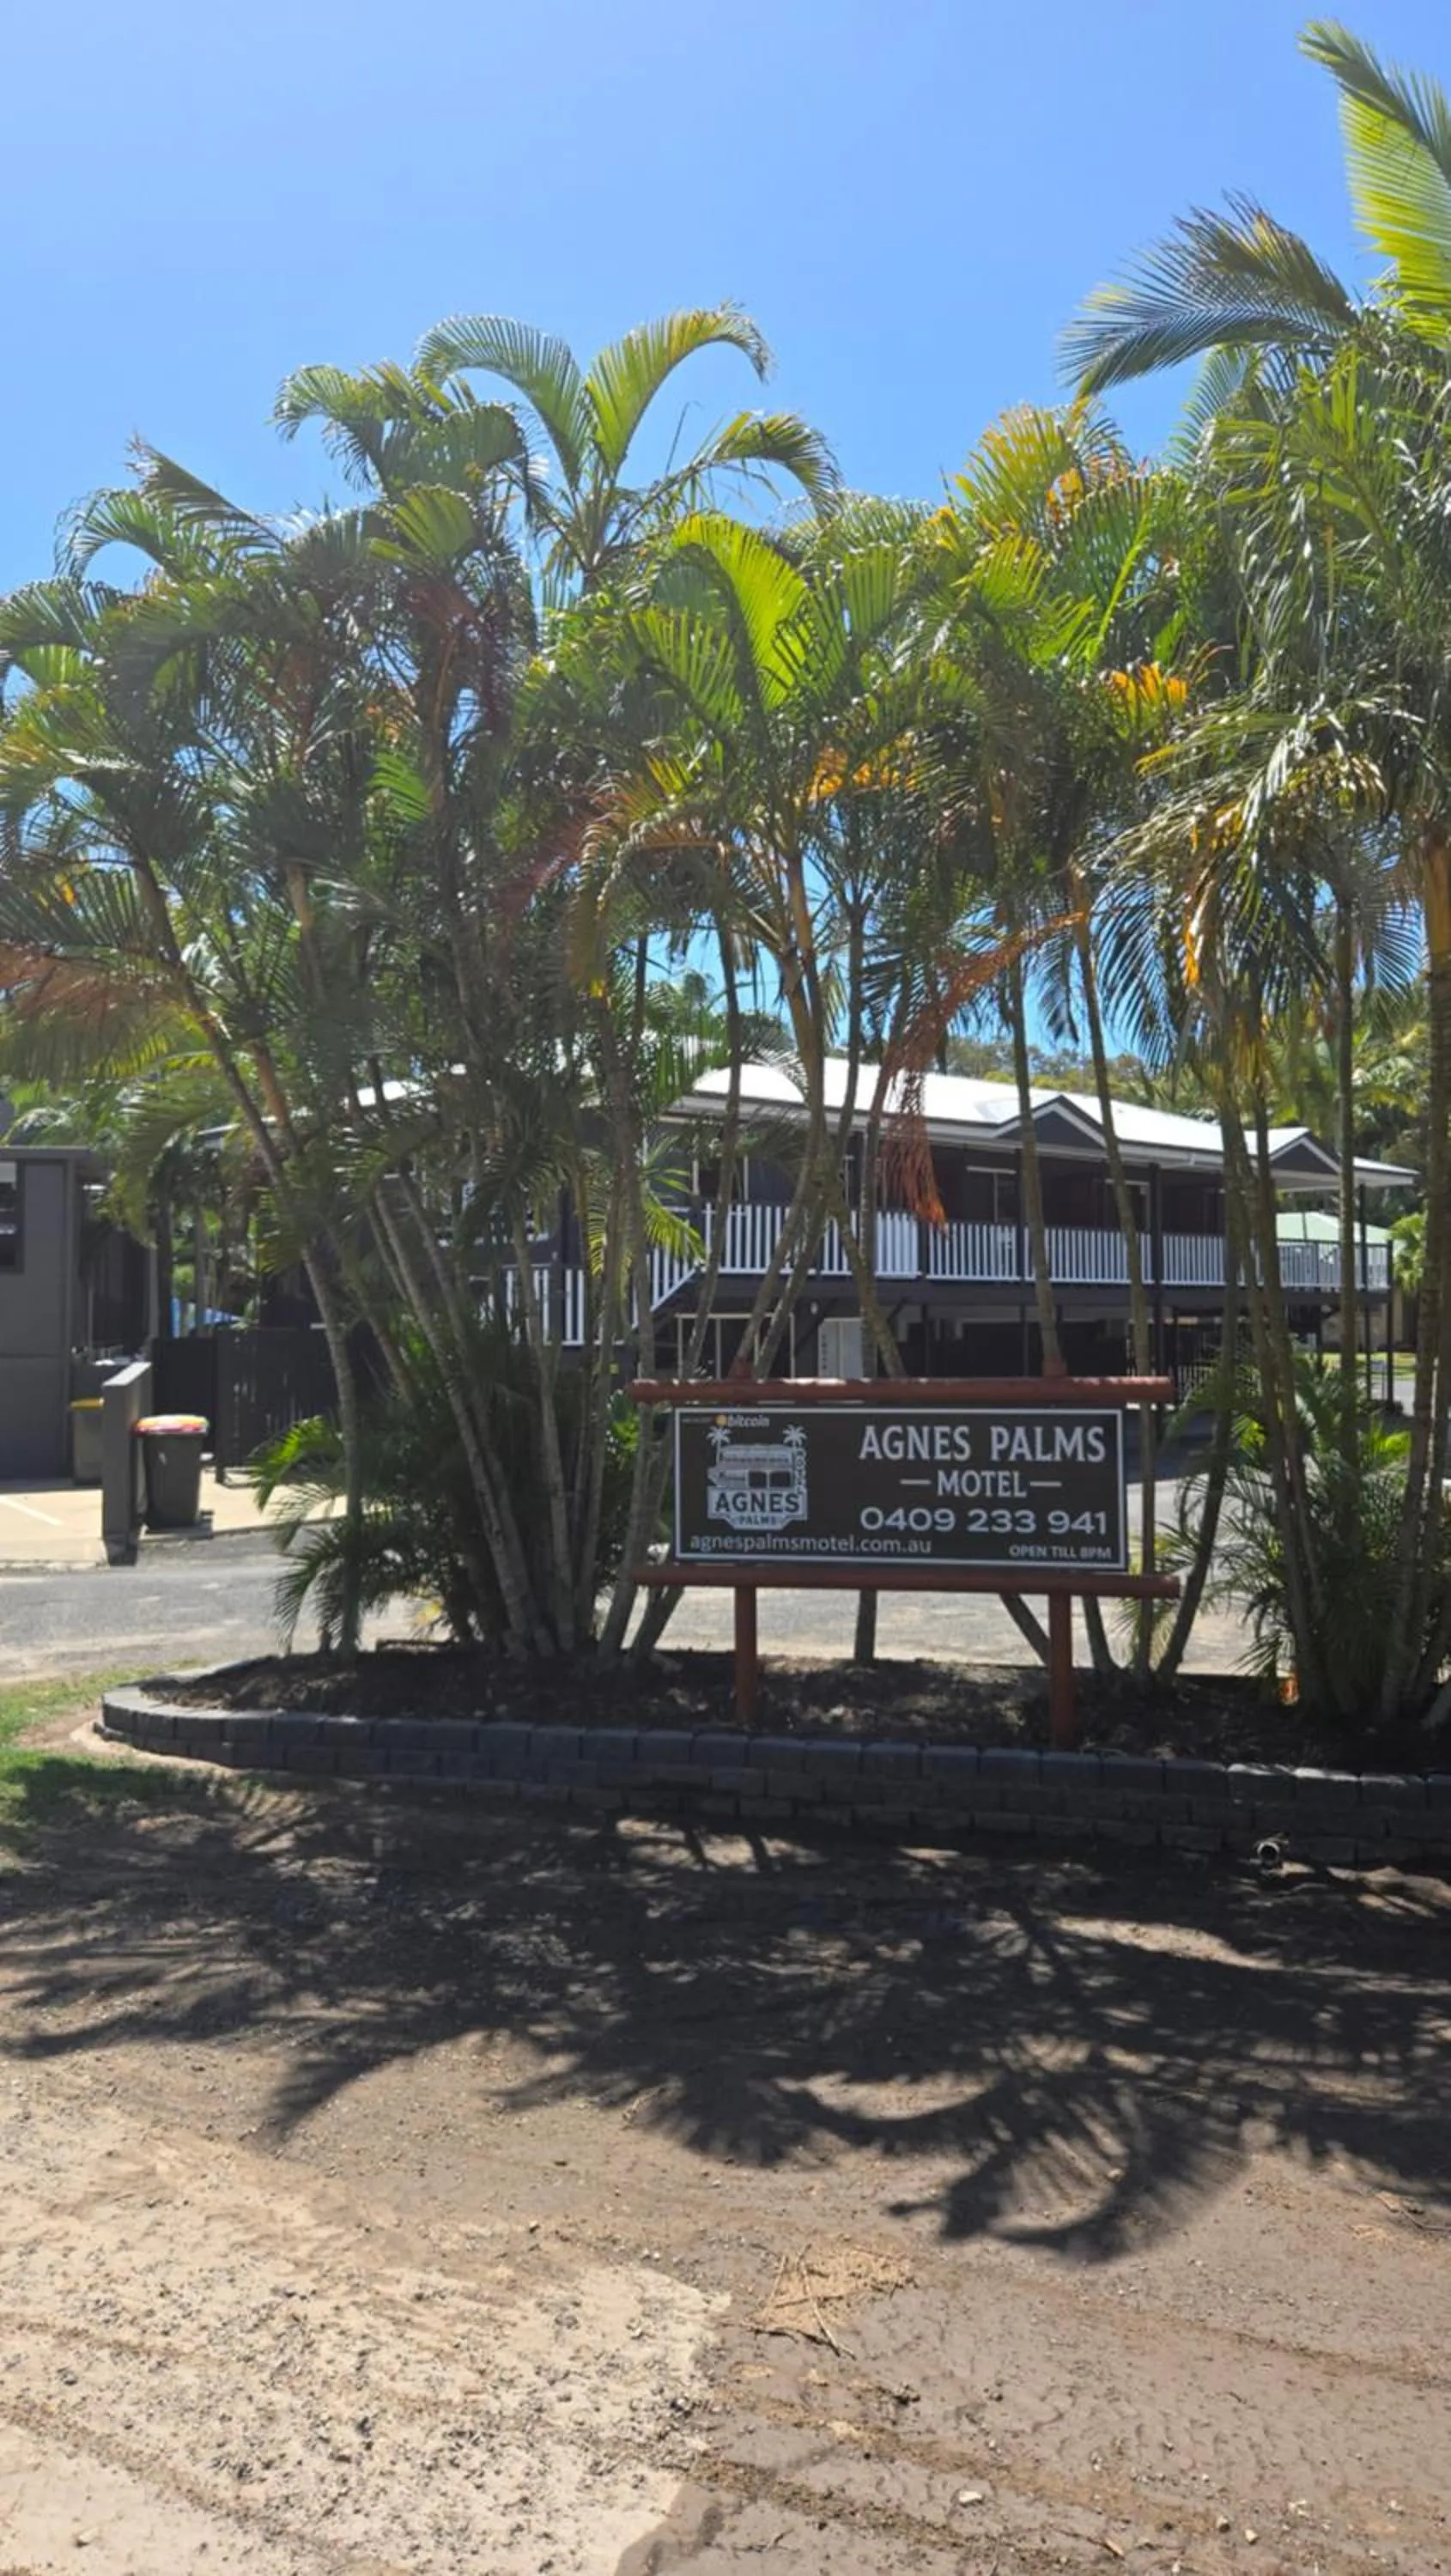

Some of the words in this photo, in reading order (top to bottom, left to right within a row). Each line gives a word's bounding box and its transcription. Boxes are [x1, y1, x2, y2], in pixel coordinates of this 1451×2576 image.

[859, 1425, 971, 1461] AGNES
[990, 1426, 1107, 1462] PALMS
[937, 1469, 1027, 1498] MOTEL
[714, 1492, 800, 1512] AGNES
[860, 1507, 956, 1532] 0409
[968, 1509, 1036, 1534] 233
[1047, 1510, 1107, 1535] 941
[689, 1533, 932, 1554] agnespalmsmotel.com.au
[1009, 1545, 1047, 1558] OPEN
[1049, 1546, 1077, 1559] TILL
